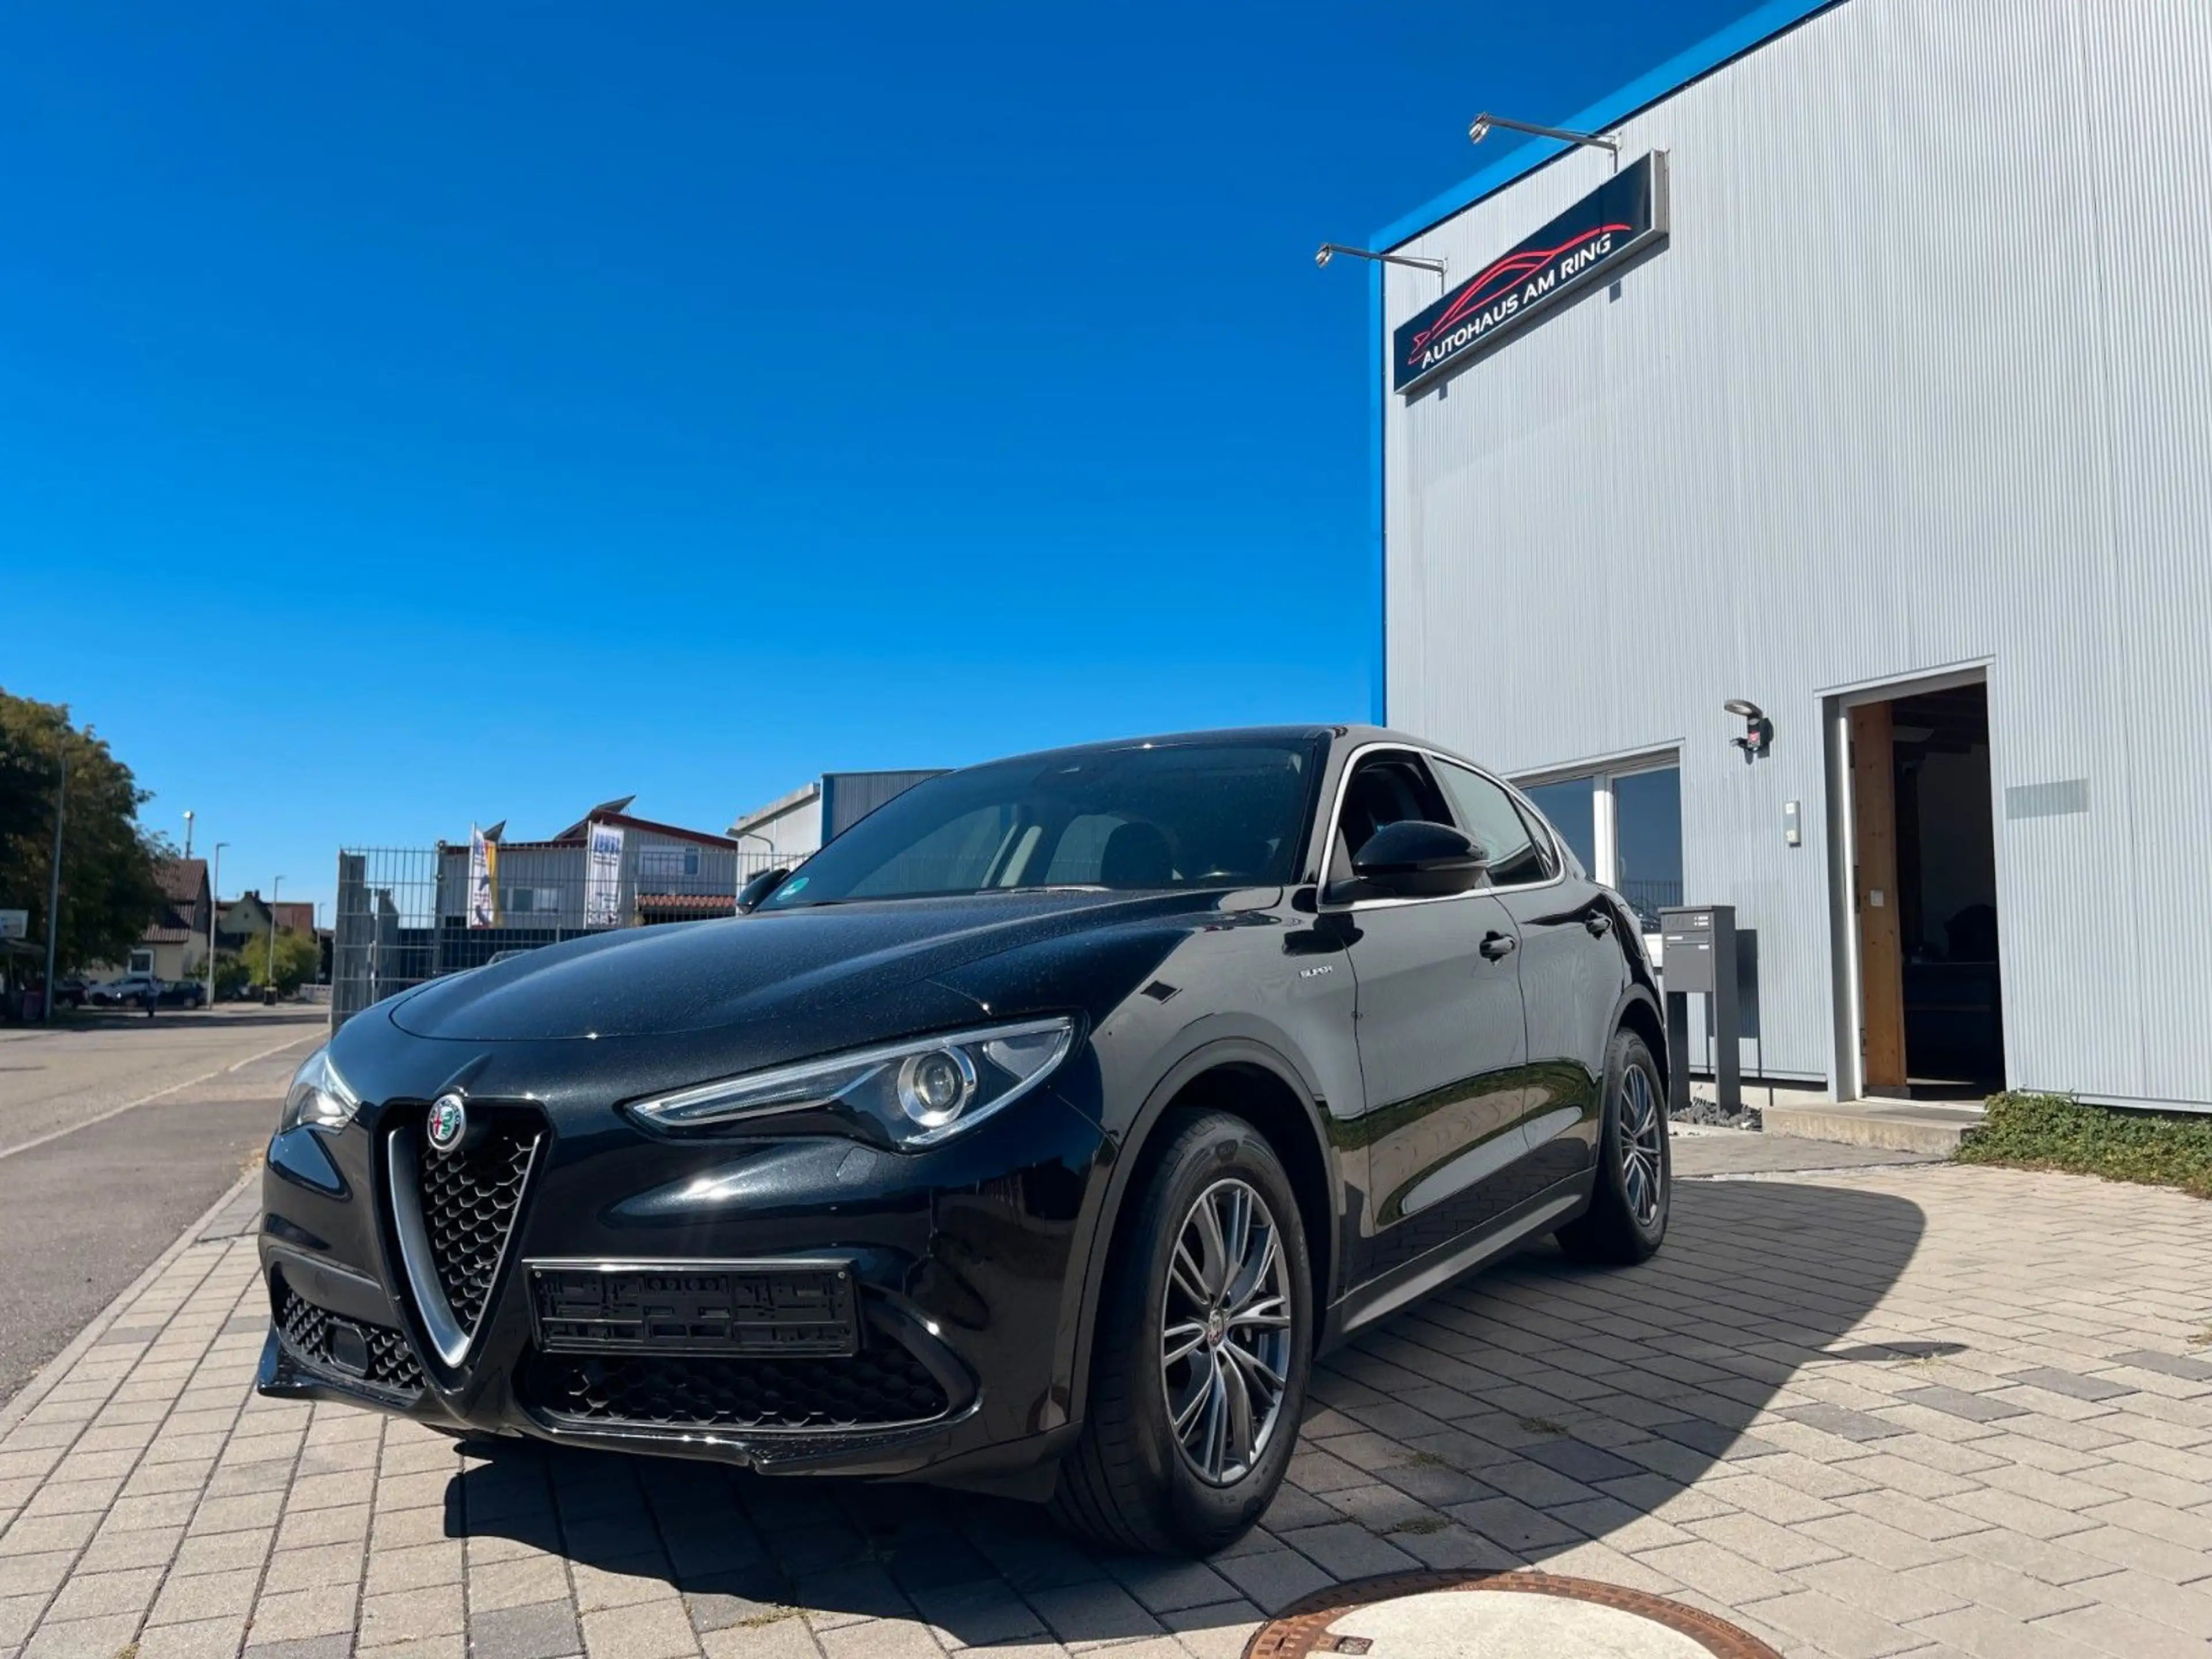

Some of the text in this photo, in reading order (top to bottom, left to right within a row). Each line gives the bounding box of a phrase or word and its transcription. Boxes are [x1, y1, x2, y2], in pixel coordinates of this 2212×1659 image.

[1422, 233, 1611, 369] AUTOHAUS AM RING
